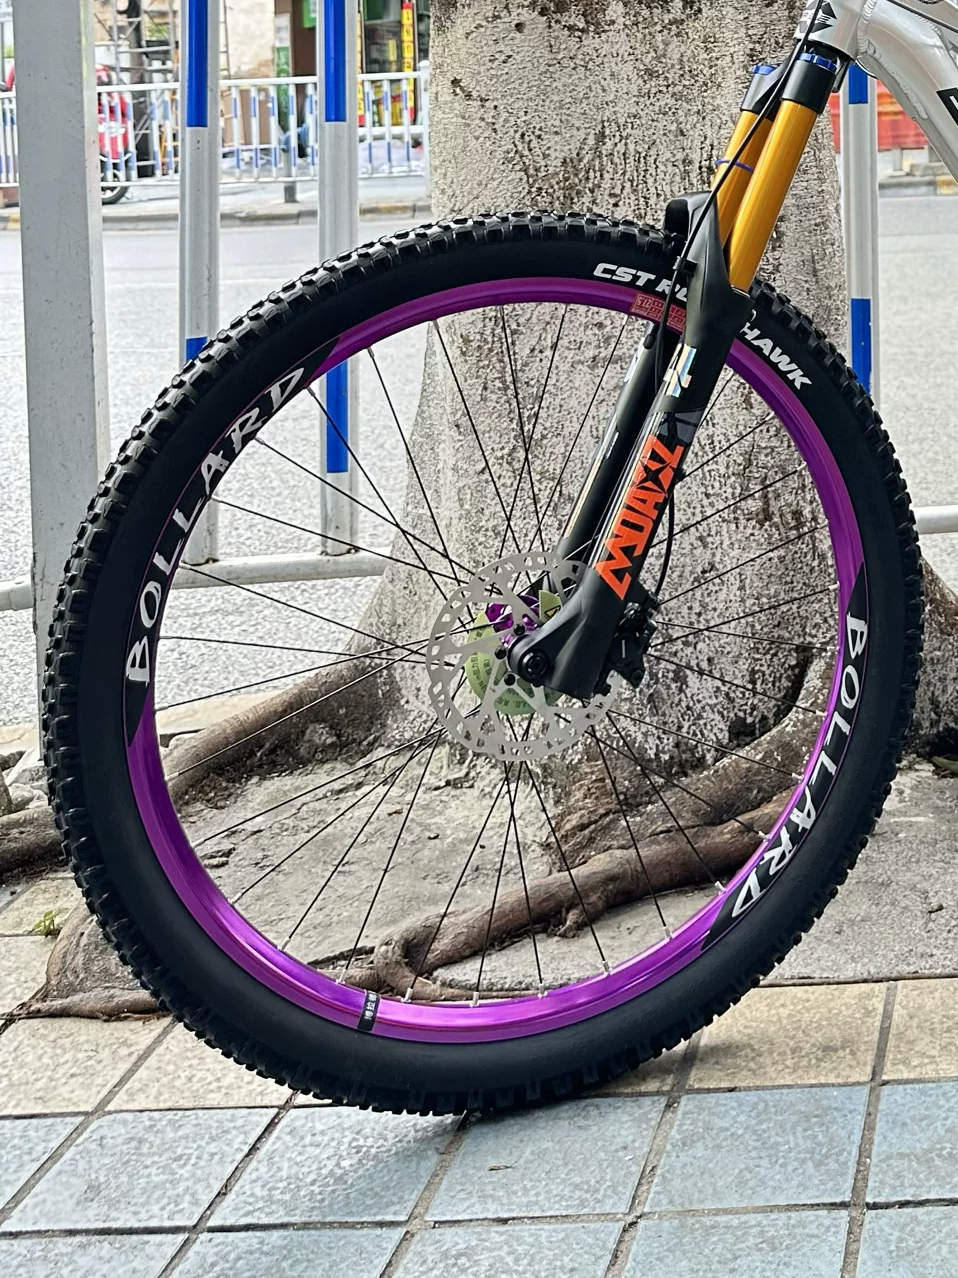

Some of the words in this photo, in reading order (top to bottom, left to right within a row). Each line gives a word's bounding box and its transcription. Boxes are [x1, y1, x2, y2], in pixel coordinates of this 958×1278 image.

[593, 263, 656, 286] CST
[739, 321, 812, 391] HAWK
[125, 367, 304, 687] BOLLARD
[732, 611, 868, 918] BOLLARD
